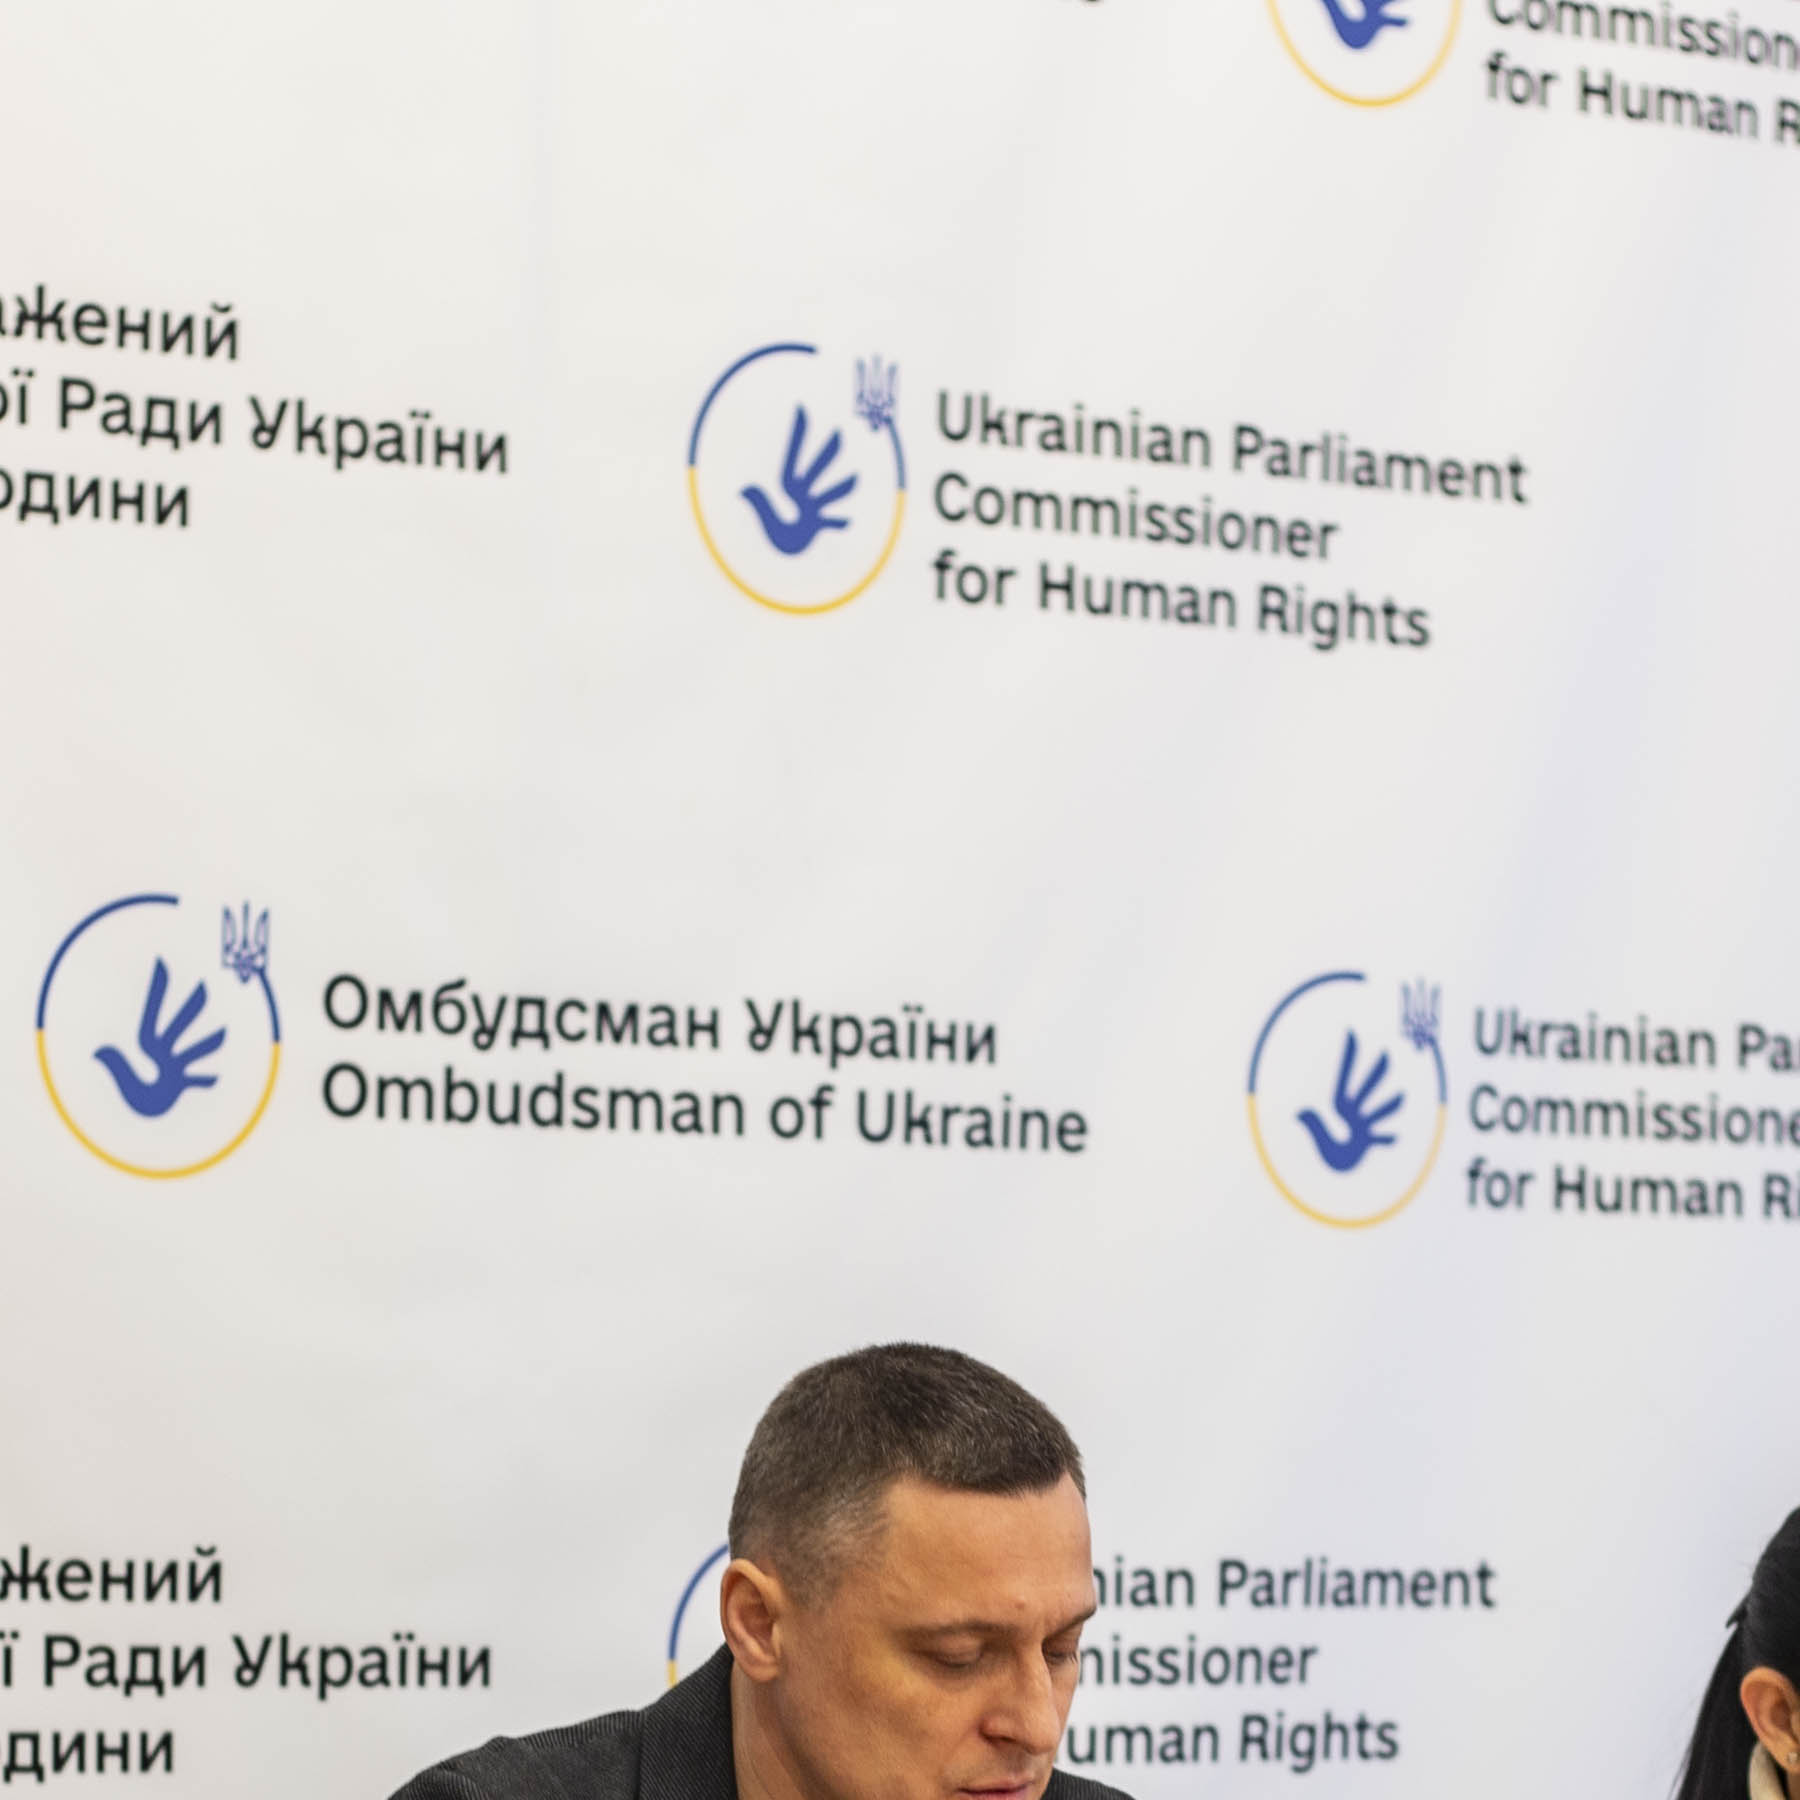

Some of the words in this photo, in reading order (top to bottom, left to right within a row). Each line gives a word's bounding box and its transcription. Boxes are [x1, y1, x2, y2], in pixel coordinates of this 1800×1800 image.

[1484, 50, 1558, 107] for
[1578, 69, 1759, 137] Human
[58, 376, 223, 452] Ради
[248, 395, 508, 475] України
[937, 390, 1212, 467] Ukrainian
[1232, 422, 1527, 505] Parliament
[932, 470, 1339, 560] Commissioner
[931, 547, 1018, 607] for
[1038, 562, 1237, 628] Human
[1257, 583, 1431, 653] Rights
[322, 972, 720, 1052] Омбудсман
[744, 998, 997, 1070] України
[1474, 1008, 1717, 1067] Ukrainian
[321, 1061, 746, 1137] Ombudsman
[768, 1083, 835, 1141] of
[856, 1089, 1089, 1155] Ukraine
[1465, 1155, 1535, 1210] for
[1552, 1166, 1744, 1218] Human
[1217, 1556, 1496, 1610] Parliament
[43, 1633, 207, 1699] Ради
[231, 1631, 492, 1703] України
[1063, 1725, 1222, 1766] uman
[1238, 1710, 1400, 1776] Rights
